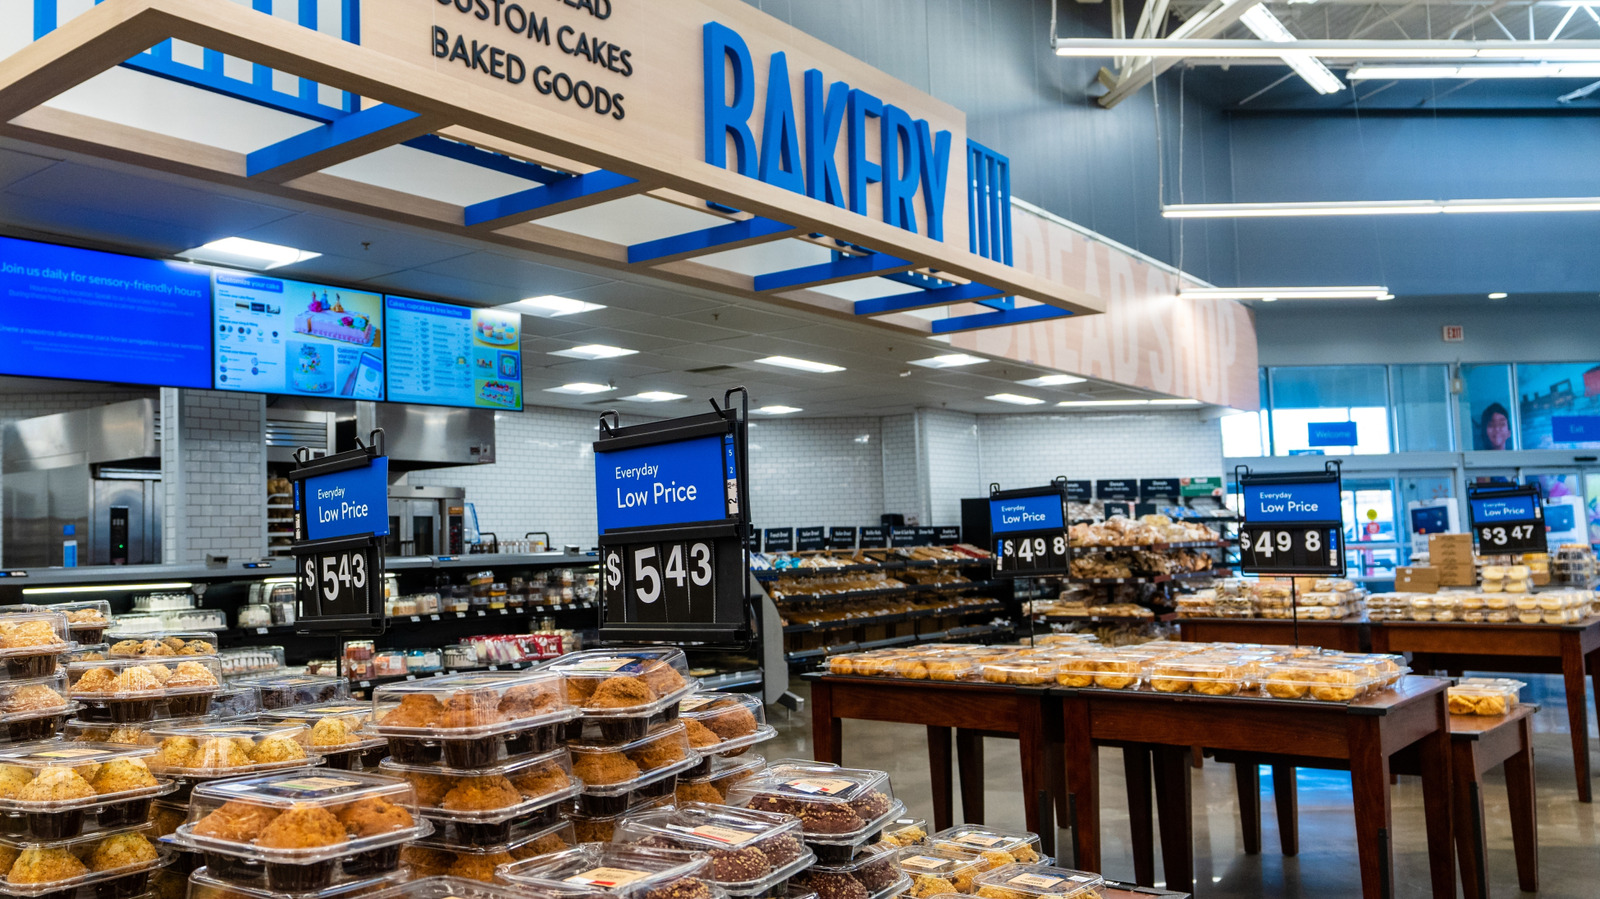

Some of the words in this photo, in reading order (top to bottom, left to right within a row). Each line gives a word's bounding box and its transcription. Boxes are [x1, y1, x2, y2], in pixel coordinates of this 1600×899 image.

[436, 0, 550, 46] STOM
[557, 26, 633, 77] CAKES
[432, 24, 526, 84] BAKED
[533, 65, 626, 120] GOODS
[703, 21, 952, 250] BAKERY
[0, 262, 24, 274] Join
[26, 267, 40, 277] us
[42, 268, 69, 282] daily
[71, 270, 87, 282] for
[88, 276, 173, 295] sensory-friendly
[174, 285, 202, 298] hours
[218, 275, 250, 286] Customize
[1448, 327, 1461, 339] EXIT
[1315, 430, 1351, 438] Welcome
[615, 464, 658, 480] Everyday
[317, 486, 346, 501] Everyday
[616, 487, 648, 508] Low
[653, 481, 697, 504] Price
[318, 506, 339, 524] Low
[341, 500, 369, 520] Price
[1261, 502, 1284, 513] Low
[1288, 501, 1318, 512] Price
[1002, 515, 1020, 524] Low
[1022, 512, 1046, 522] Price
